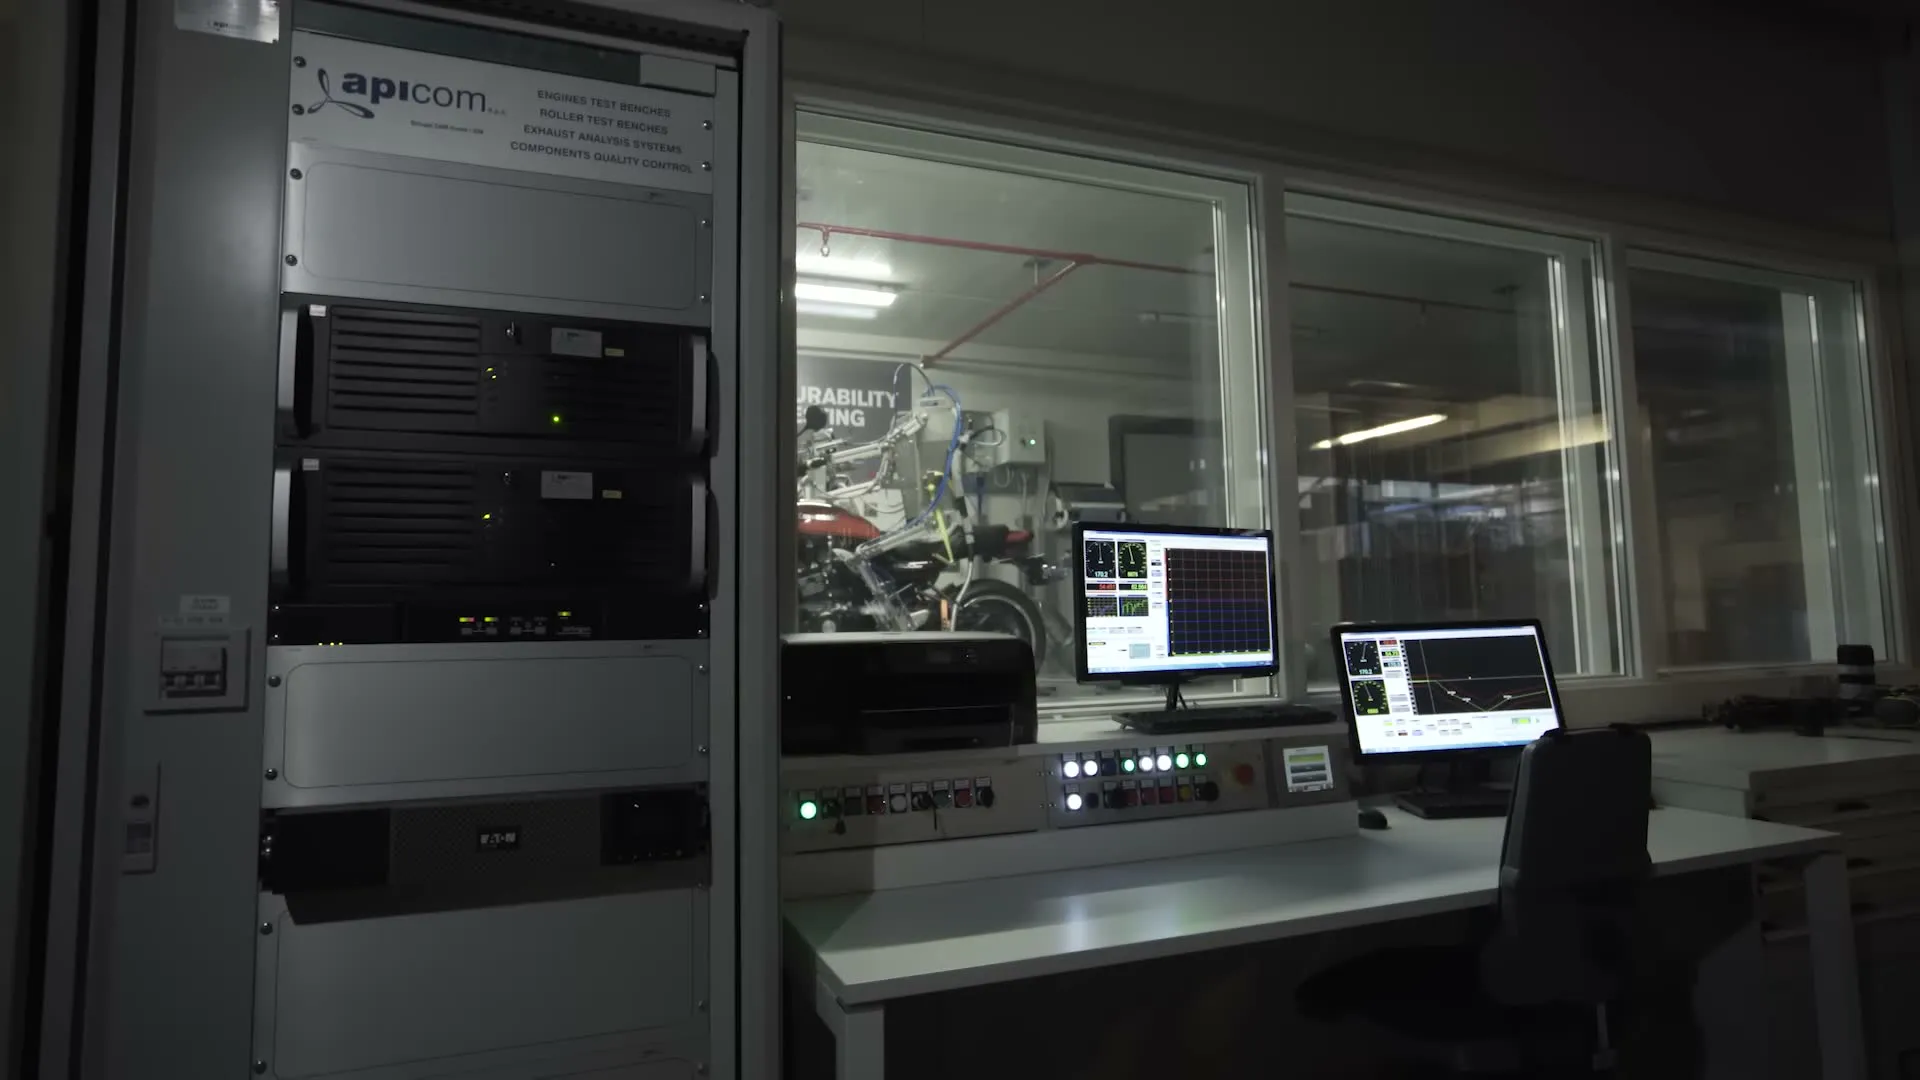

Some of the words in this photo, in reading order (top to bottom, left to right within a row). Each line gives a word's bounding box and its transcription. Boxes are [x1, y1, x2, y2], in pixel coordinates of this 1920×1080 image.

[342, 72, 486, 112] apicom
[537, 90, 587, 105] ENGINES
[591, 97, 616, 110] TEST
[620, 102, 671, 118] BENCHES
[540, 108, 584, 123] ROLLER
[587, 115, 613, 128] TEST
[617, 119, 669, 135] BENCHES
[524, 124, 575, 139] EXHAUST
[578, 132, 630, 148] ANALYSIS
[632, 139, 683, 154] SYSTEMS
[510, 141, 591, 160] COMPONENTS
[594, 152, 640, 166] QUALITY
[641, 158, 693, 174] CONTROL
